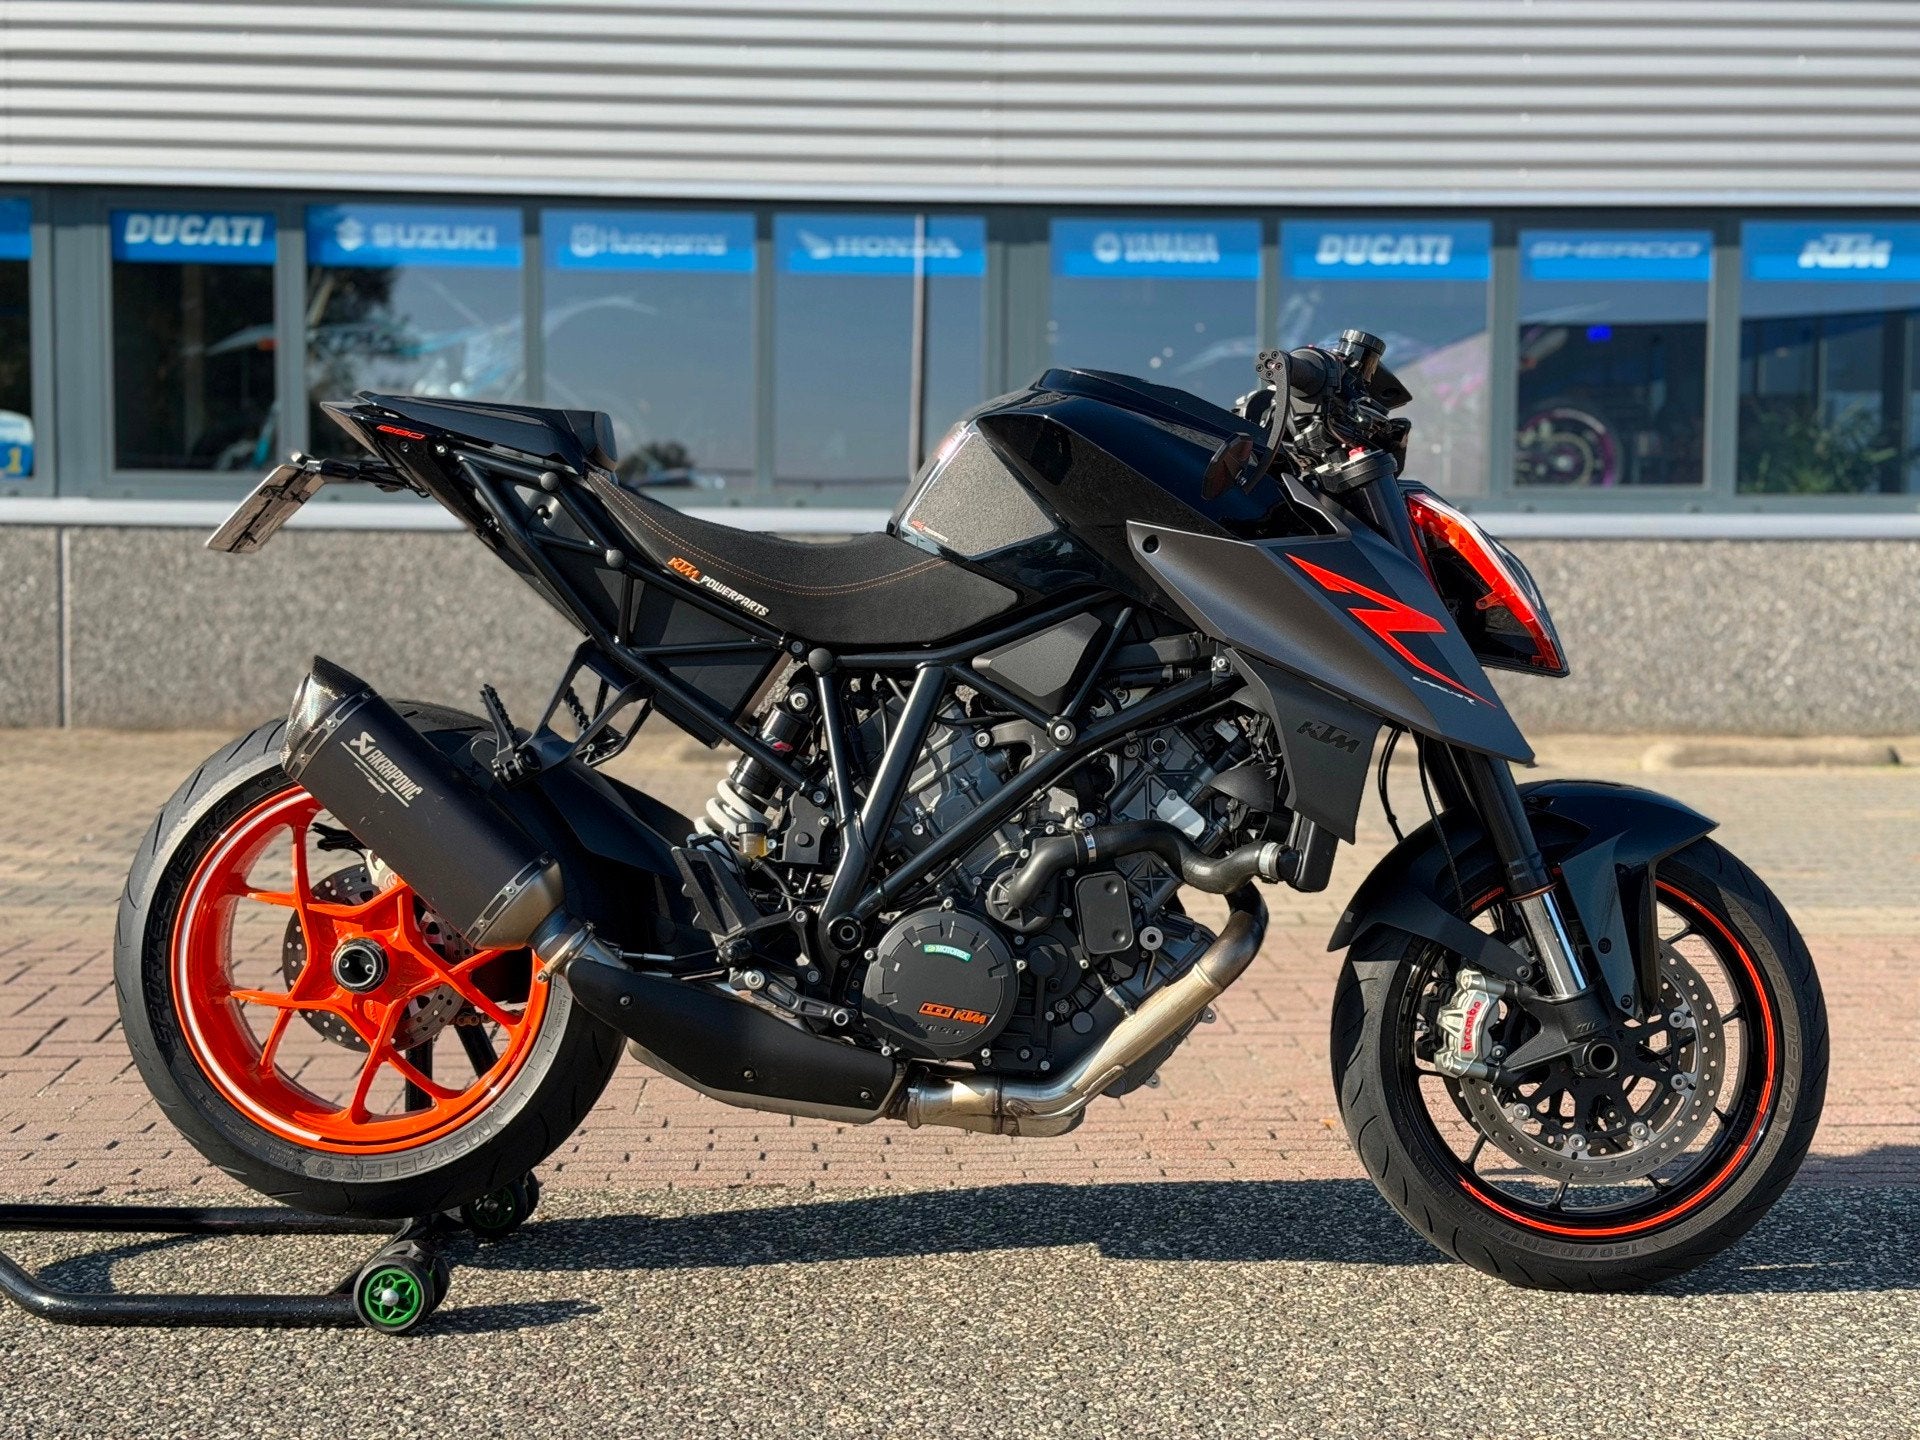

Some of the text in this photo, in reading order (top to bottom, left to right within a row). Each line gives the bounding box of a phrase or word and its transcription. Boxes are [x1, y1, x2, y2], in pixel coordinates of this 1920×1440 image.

[125, 214, 264, 247] DUCATI
[372, 224, 497, 251] SUZUKI
[835, 235, 961, 258] HONDA
[1316, 234, 1453, 265] DUCATI
[1529, 241, 1701, 259] SHERCO
[1798, 233, 1893, 269] KTM
[667, 557, 770, 617] KTM POWERPARTS
[1296, 720, 1362, 754] KTM
[953, 1009, 988, 1025] KTM
[1461, 1001, 1482, 1053] brembo
[342, 1119, 494, 1179] METZELER
